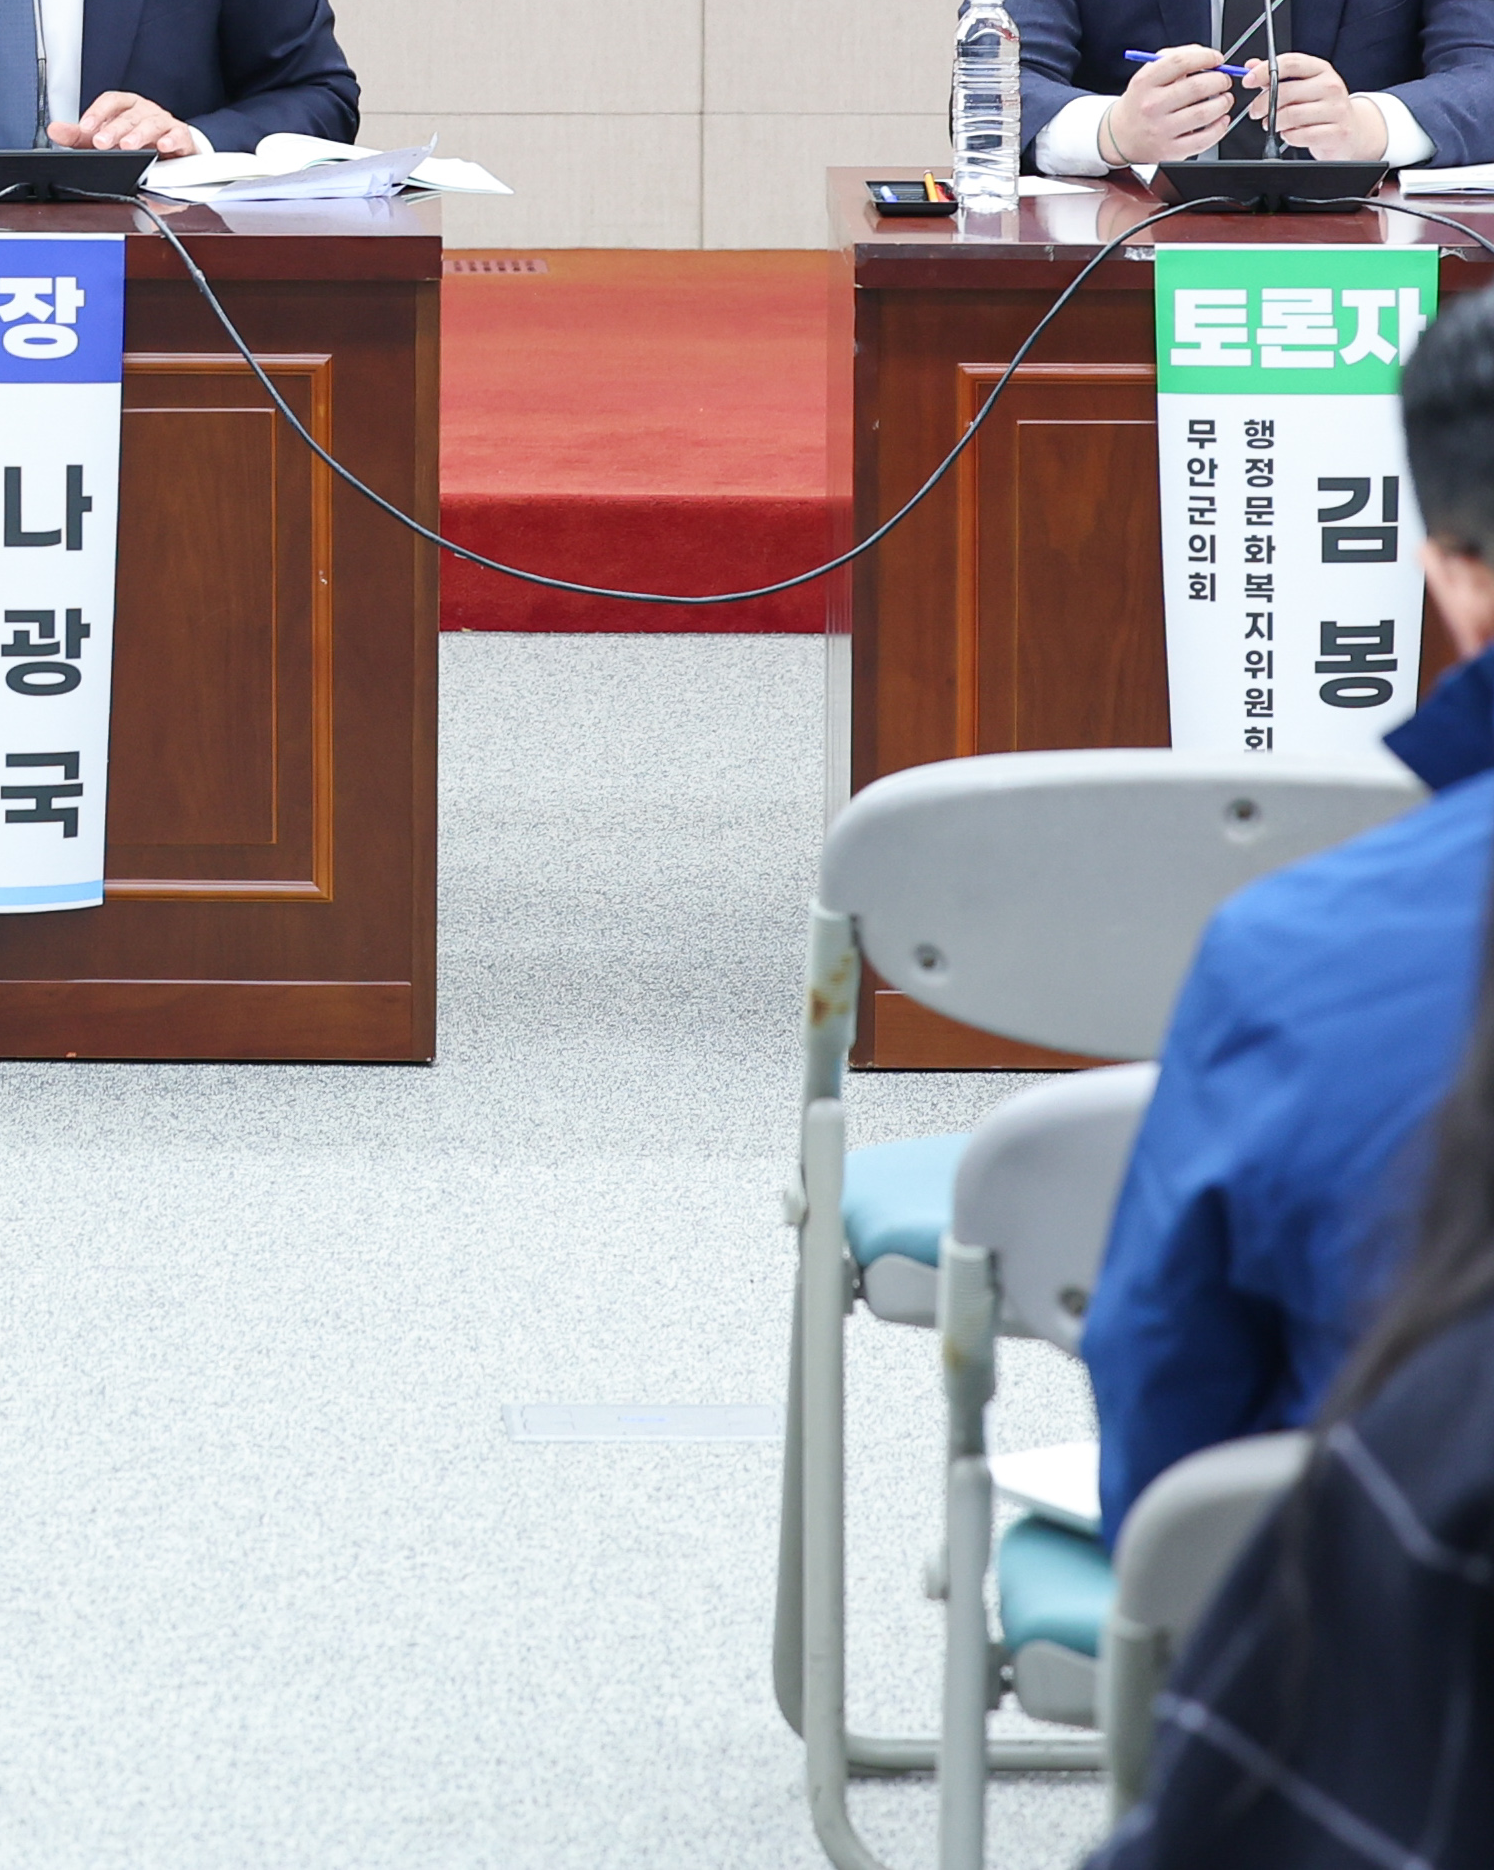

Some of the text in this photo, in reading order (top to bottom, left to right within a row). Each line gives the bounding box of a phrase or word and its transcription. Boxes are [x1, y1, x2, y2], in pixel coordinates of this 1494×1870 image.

[1169, 286, 1426, 370] 토론자
[1186, 419, 1218, 602] 무안군의회
[1243, 419, 1275, 754] 행정문화복지위원회
[0, 465, 93, 838] 나광국
